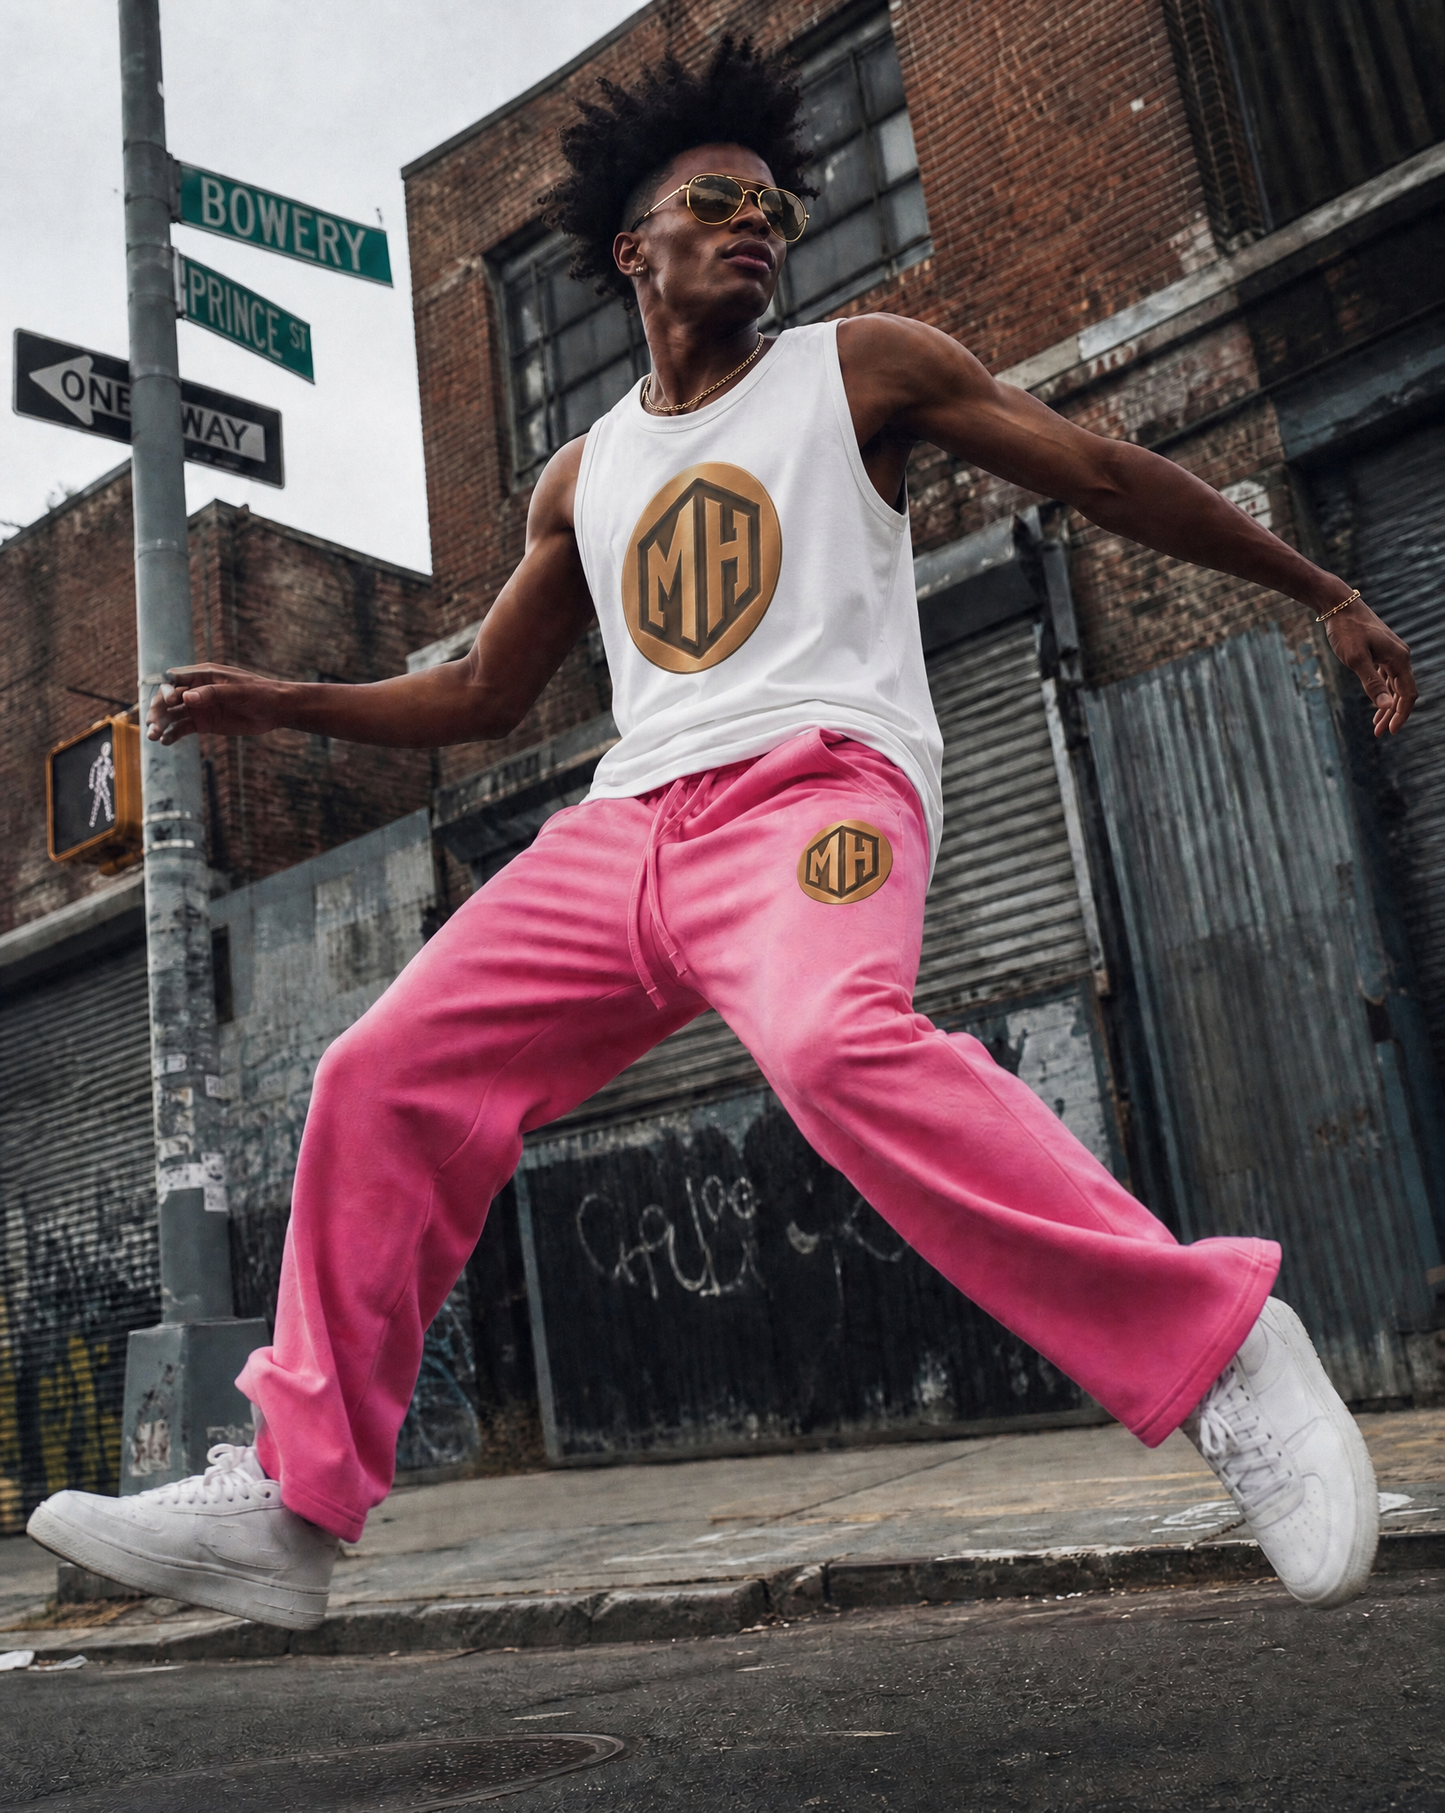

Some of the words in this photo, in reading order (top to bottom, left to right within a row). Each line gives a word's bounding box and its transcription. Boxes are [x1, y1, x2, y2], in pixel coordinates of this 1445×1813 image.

[201, 175, 367, 272] BOWERY
[188, 265, 283, 360] PRINCE
[289, 321, 307, 353] ST
[61, 369, 131, 418] ONE
[181, 405, 249, 451] WAY
[647, 494, 752, 647] MH
[808, 831, 874, 893] MH
